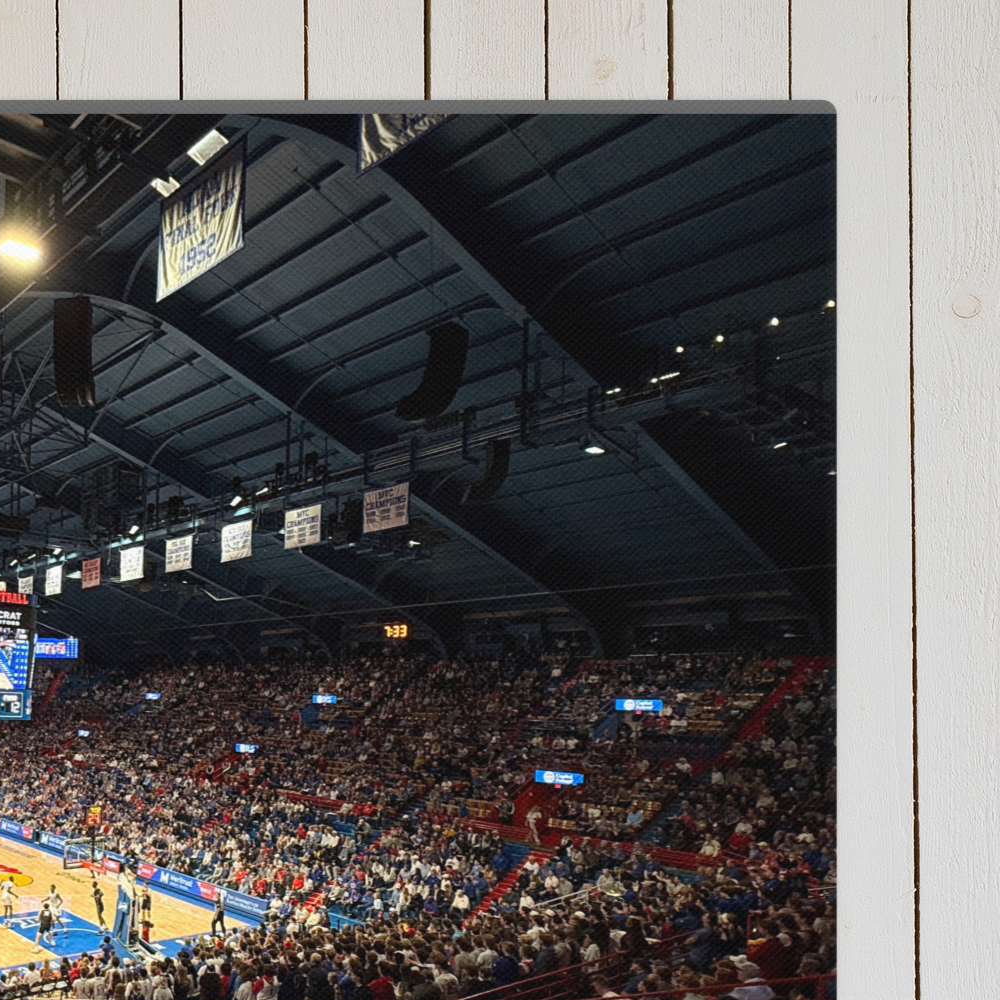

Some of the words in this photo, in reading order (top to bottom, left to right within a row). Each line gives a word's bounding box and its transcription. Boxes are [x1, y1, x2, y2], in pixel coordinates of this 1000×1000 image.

[180, 232, 217, 275] 1952
[377, 488, 394, 499] MVC
[365, 494, 407, 511] CHAMPIONS
[384, 624, 408, 638] 7:33
